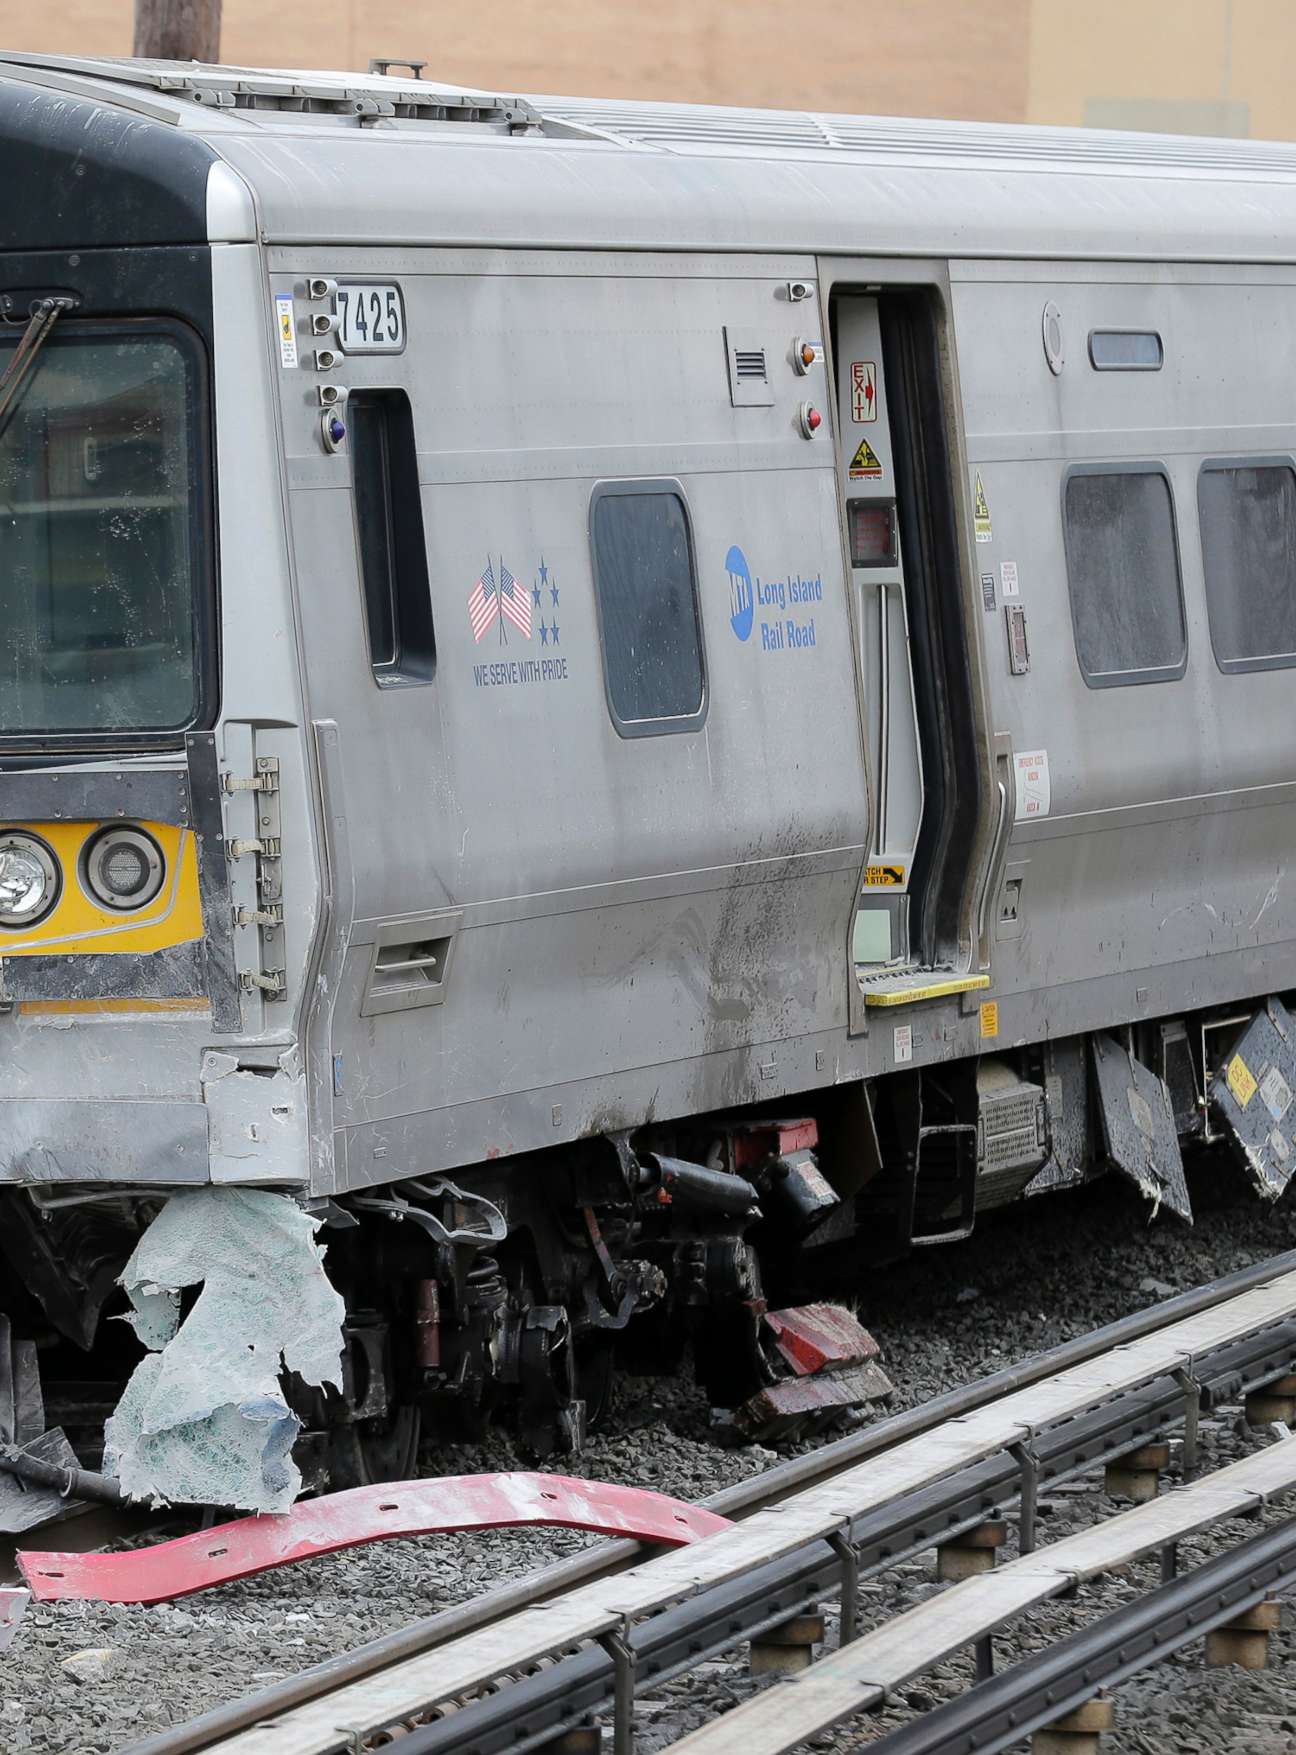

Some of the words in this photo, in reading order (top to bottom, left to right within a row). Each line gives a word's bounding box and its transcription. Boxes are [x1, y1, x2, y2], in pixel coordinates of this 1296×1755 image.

[337, 291, 399, 341] 7425
[853, 365, 864, 420] EXIT
[756, 577, 785, 610] Long
[787, 573, 822, 602] Island
[761, 621, 784, 650] Rail
[786, 619, 816, 648] Road
[473, 664, 489, 687] WE
[489, 663, 518, 685] SERVE
[518, 660, 541, 682] WITH
[542, 659, 568, 680] PRIDE
[871, 876, 888, 884] STEP
